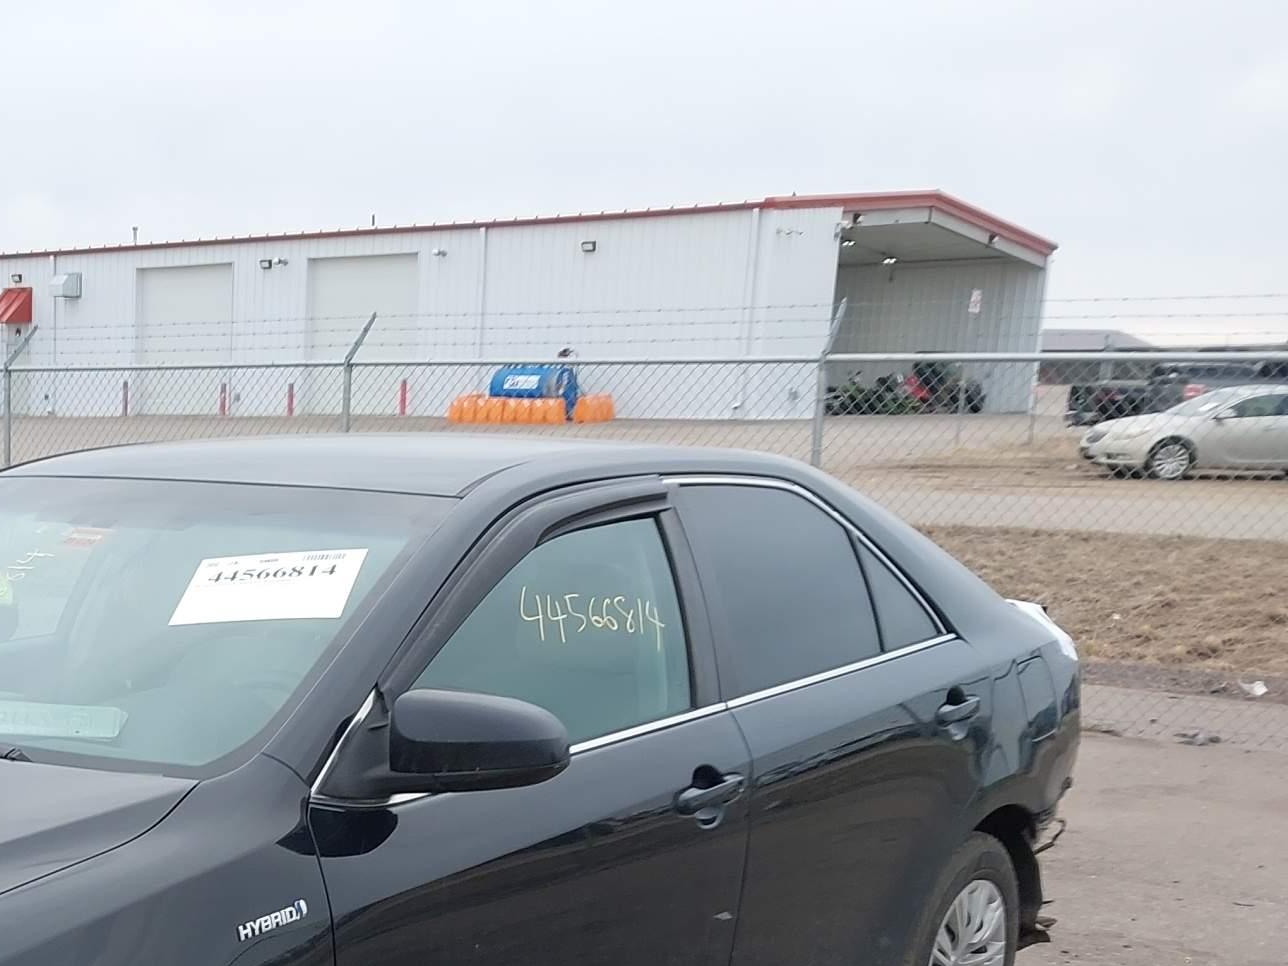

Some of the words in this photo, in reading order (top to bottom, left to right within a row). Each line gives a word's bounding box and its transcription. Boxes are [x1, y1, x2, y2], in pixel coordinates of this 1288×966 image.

[207, 564, 337, 583] 44566814
[520, 586, 666, 651] 44566814
[237, 906, 297, 941] HYBRID
